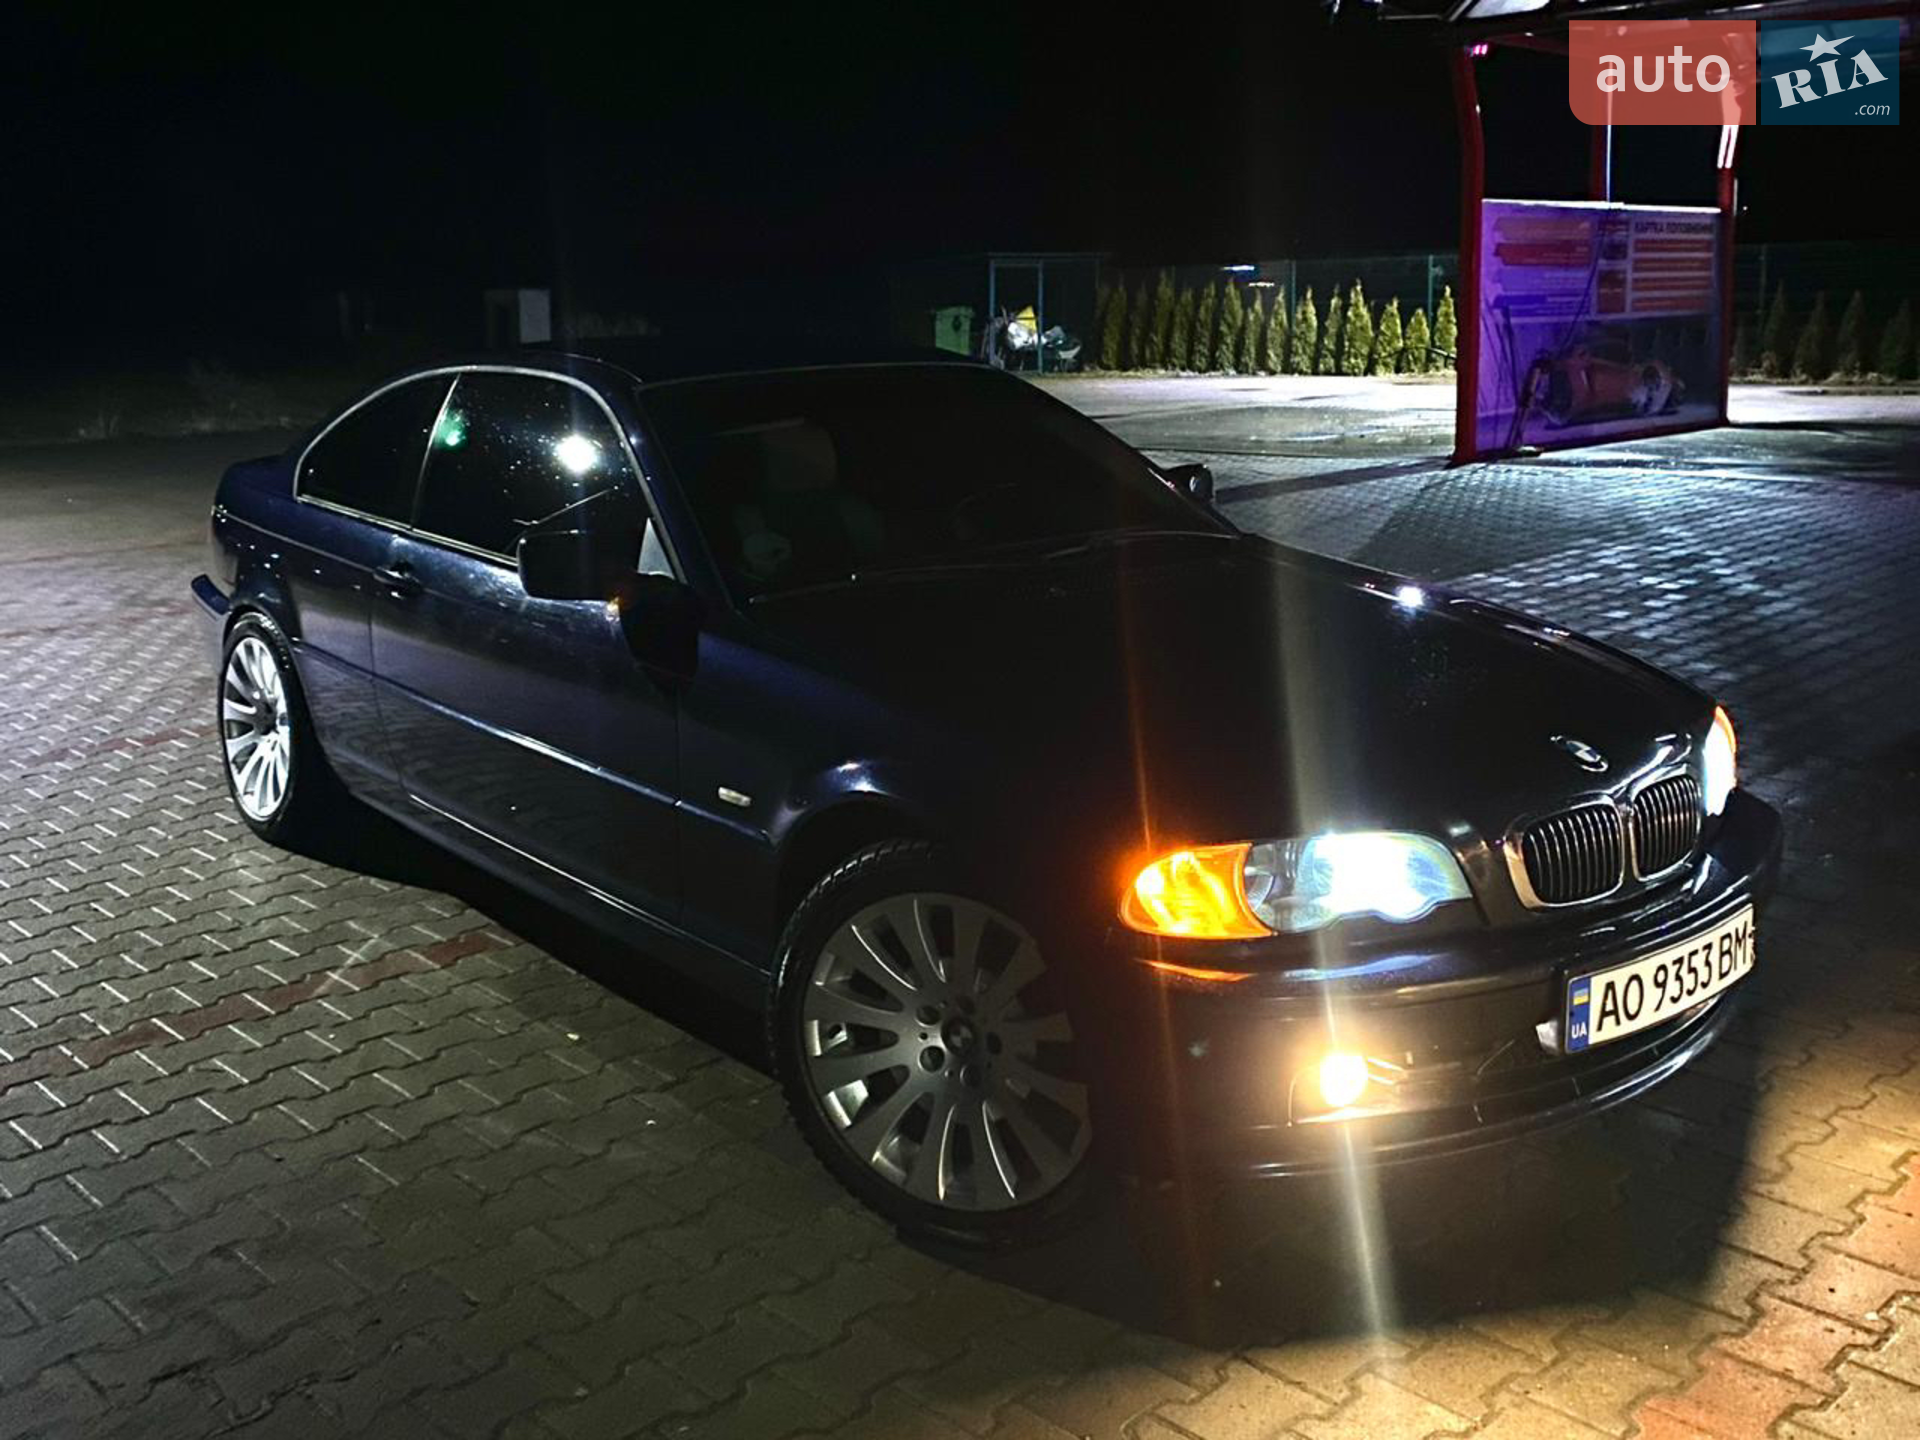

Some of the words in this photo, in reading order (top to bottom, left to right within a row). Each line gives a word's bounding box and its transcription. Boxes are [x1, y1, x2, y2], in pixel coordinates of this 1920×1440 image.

[1597, 973, 1644, 1032] AO
[1653, 941, 1713, 1013] 9353
[1718, 920, 1748, 981] BM
[1571, 1022, 1588, 1039] UA
